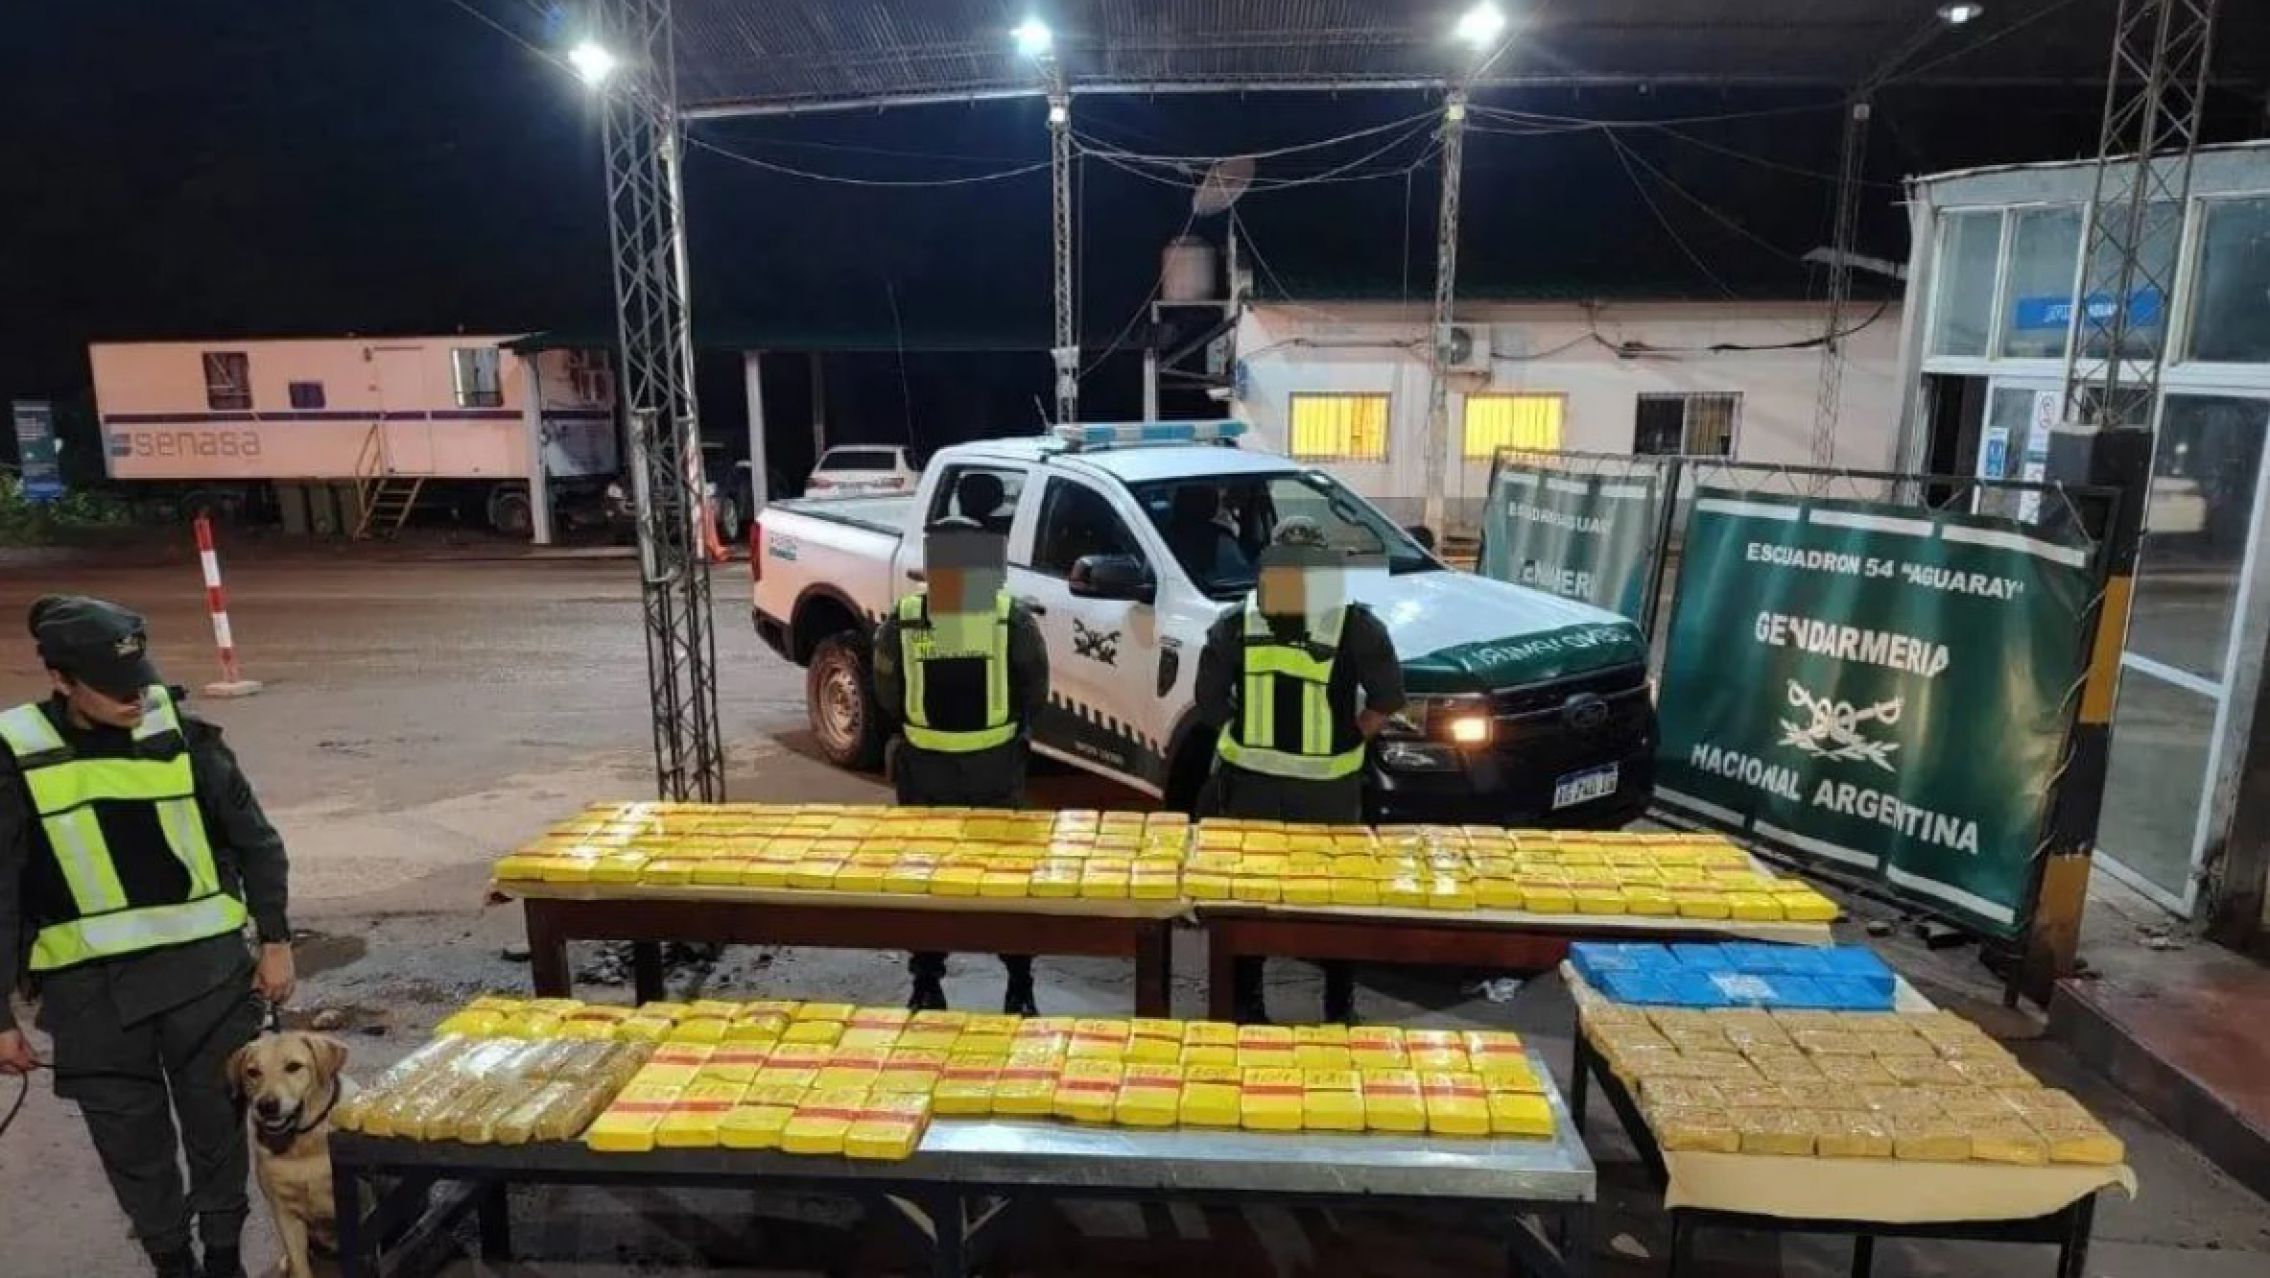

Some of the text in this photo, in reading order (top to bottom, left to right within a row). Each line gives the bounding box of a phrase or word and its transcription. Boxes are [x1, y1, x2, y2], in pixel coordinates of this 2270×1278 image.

[135, 431, 260, 457] senasa
[1746, 542, 1860, 575] ESCUADRON
[1864, 557, 1894, 578] 54
[1754, 611, 1950, 678] GENDARMERIA
[1690, 744, 1801, 801] NACIONAL
[1812, 779, 1980, 855] ARGENTINA
